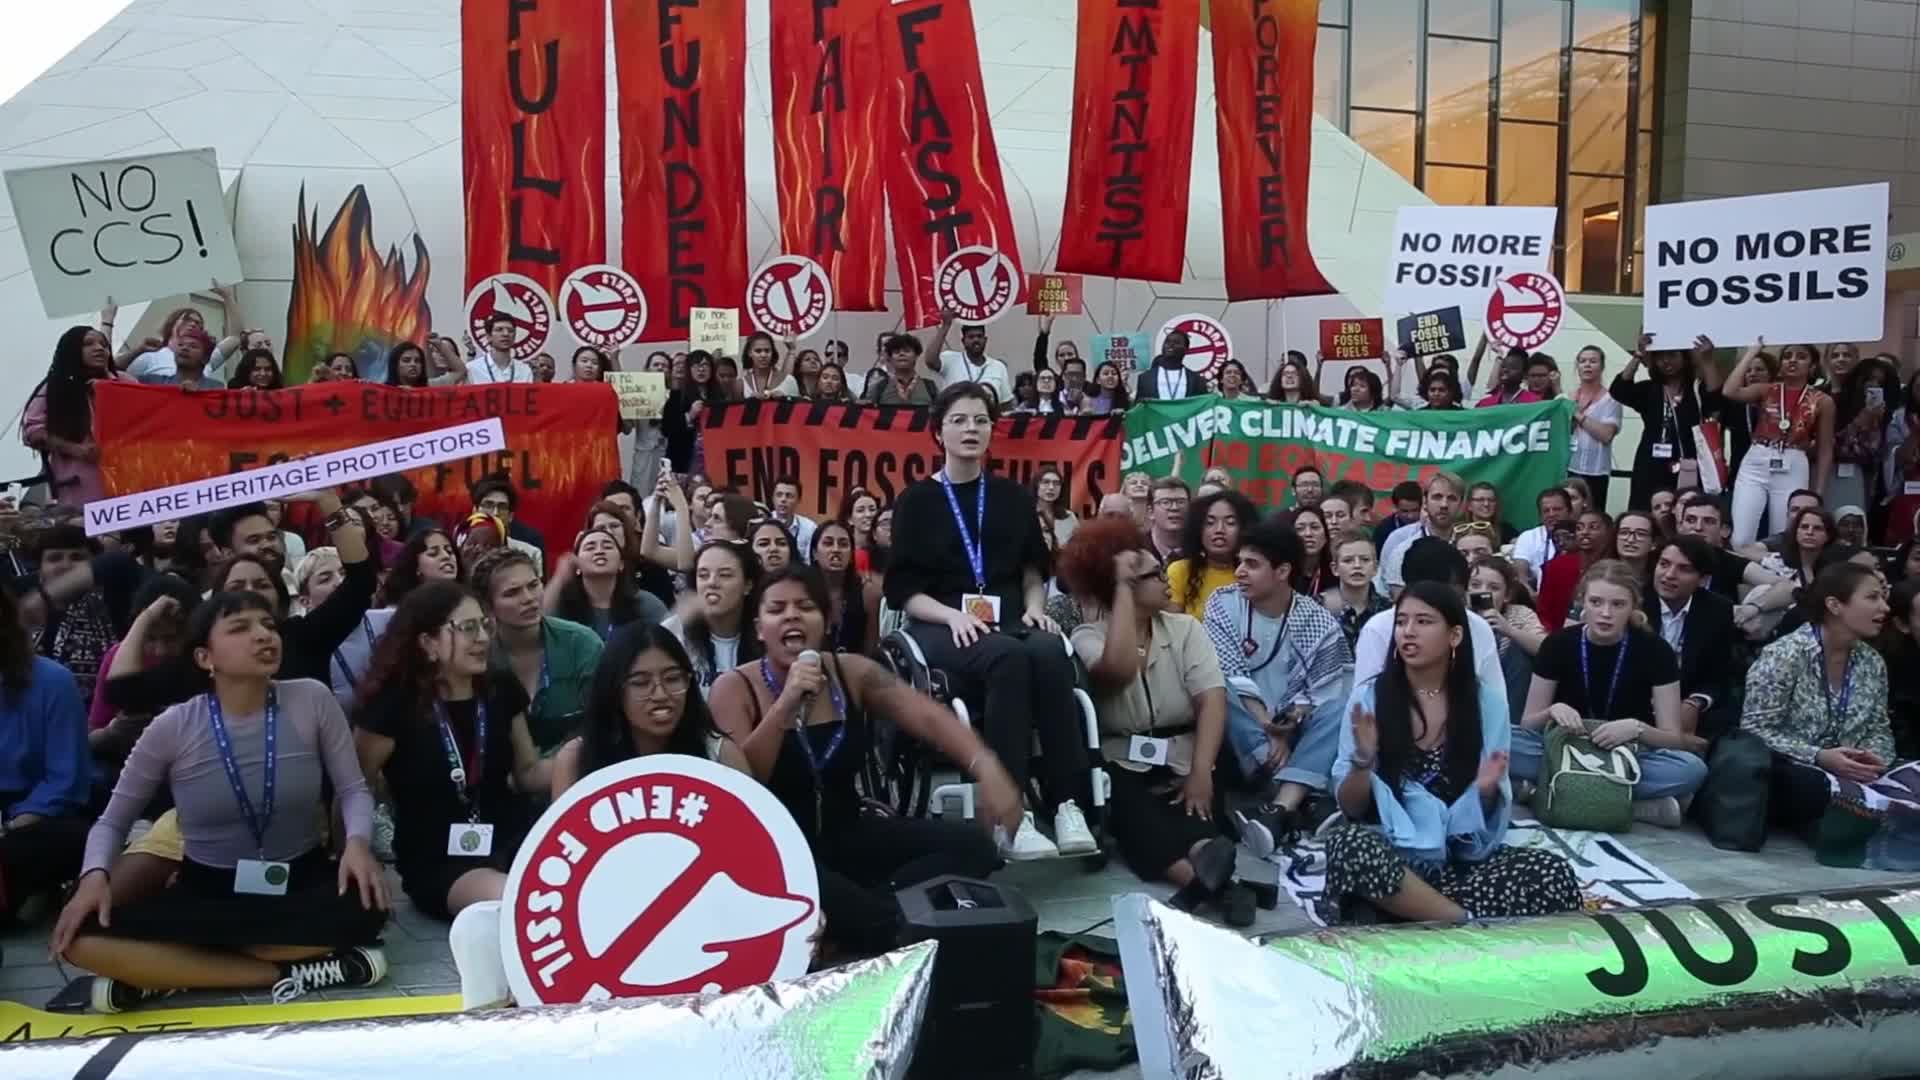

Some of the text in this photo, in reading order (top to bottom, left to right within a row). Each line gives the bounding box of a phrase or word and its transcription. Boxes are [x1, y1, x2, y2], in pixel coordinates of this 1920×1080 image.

[508, 0, 562, 264] FULL
[812, 0, 847, 256] FAIR
[896, 3, 974, 254] FAST
[1096, 0, 1159, 268] MINIST
[658, 0, 709, 329] FUNDED
[71, 165, 157, 219] NO
[51, 198, 208, 275] CCS!
[1400, 232, 1542, 256] NO MORE
[1658, 223, 1871, 267] NO MORE
[601, 273, 639, 305] FUELS
[983, 281, 1009, 316] FUELS
[1038, 288, 1070, 301] FOSSIL
[1045, 277, 1063, 288] END
[1526, 276, 1560, 309] FUELS
[1658, 267, 1869, 309] FOSSILS
[522, 290, 548, 332] FUELS
[798, 292, 824, 331] FUELS
[1039, 300, 1069, 313] FUELS
[1416, 314, 1439, 330] END
[1111, 336, 1129, 348] END
[1333, 333, 1370, 346] FOSSIL
[1341, 322, 1362, 334] END
[1410, 326, 1450, 343] FOSSIL
[1415, 339, 1450, 354] FUELS
[1104, 348, 1137, 360] FOSSIL
[1336, 345, 1370, 359] FUELS
[203, 387, 305, 423] JUST
[361, 386, 540, 421] EQUITABLE
[1120, 405, 1551, 471] DELIVER CLIMATE FINANCE
[91, 502, 132, 528] WE
[137, 488, 190, 519] ARE
[196, 462, 320, 507] HERITAGE
[326, 427, 491, 479] PROTECTORS
[817, 448, 945, 514] FOSS
[1260, 441, 1441, 489] EQTABL
[526, 785, 709, 988] #END FOSSIL
[1585, 884, 1920, 998] JUST
